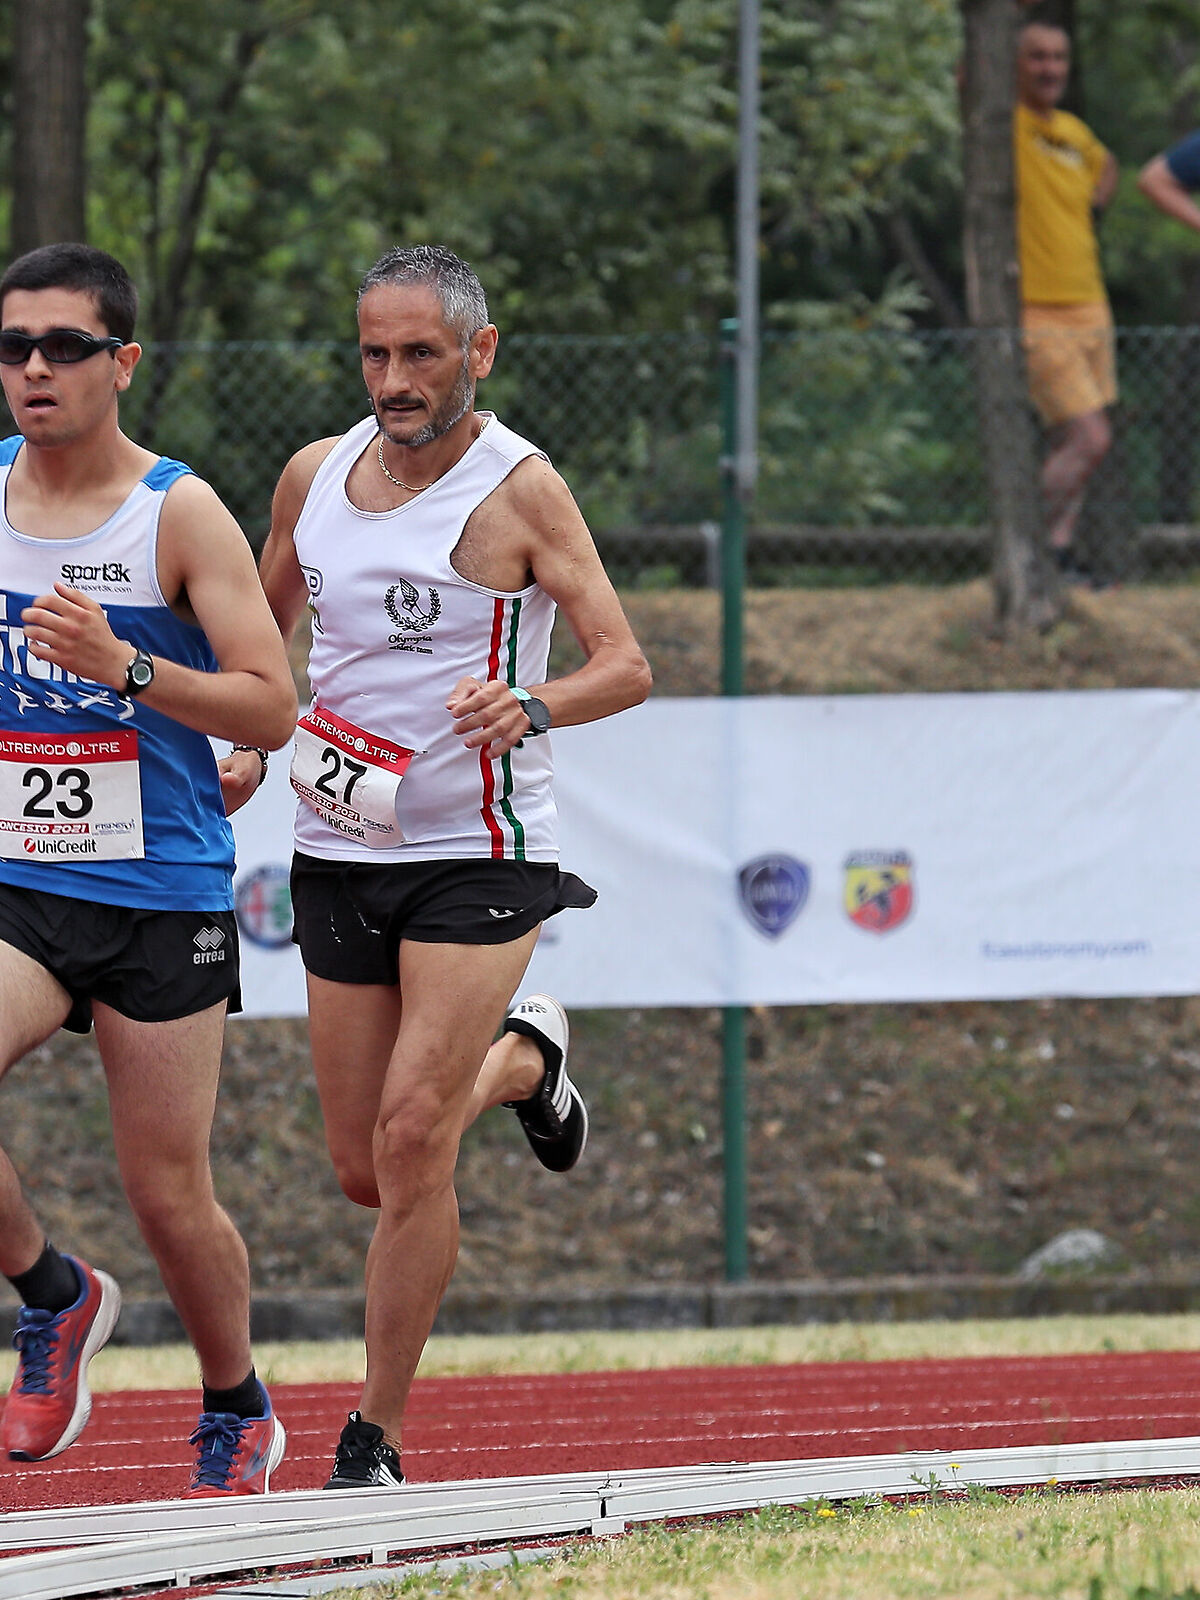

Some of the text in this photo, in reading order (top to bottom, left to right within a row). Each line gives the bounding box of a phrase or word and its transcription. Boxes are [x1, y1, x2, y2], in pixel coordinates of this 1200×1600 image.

[61, 563, 131, 583] sport3k
[388, 633, 432, 646] Olympia
[315, 747, 367, 805] 27
[22, 767, 93, 819] 23
[335, 806, 359, 820] 2021
[51, 823, 87, 834] 2021
[37, 839, 97, 854] UniCredit
